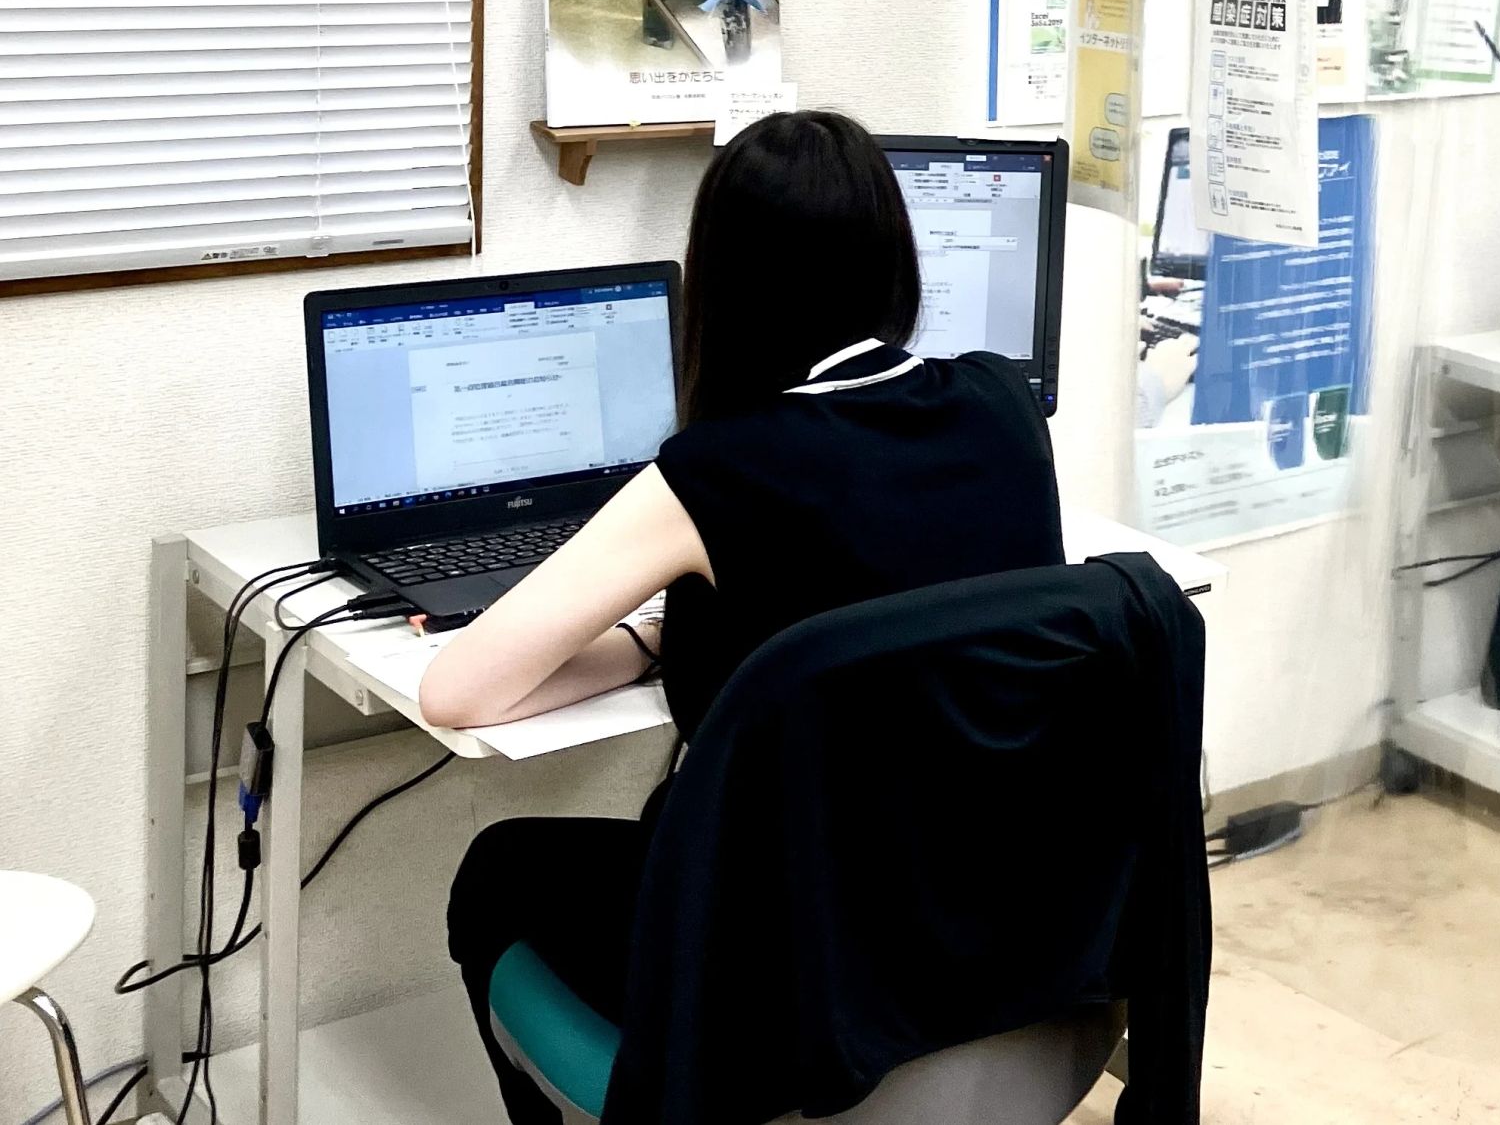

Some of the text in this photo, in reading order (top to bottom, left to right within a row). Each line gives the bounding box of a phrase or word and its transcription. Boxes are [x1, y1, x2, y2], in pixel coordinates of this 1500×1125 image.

[629, 70, 725, 84] 思い出をかたちに
[508, 497, 532, 509] FUJITSU
